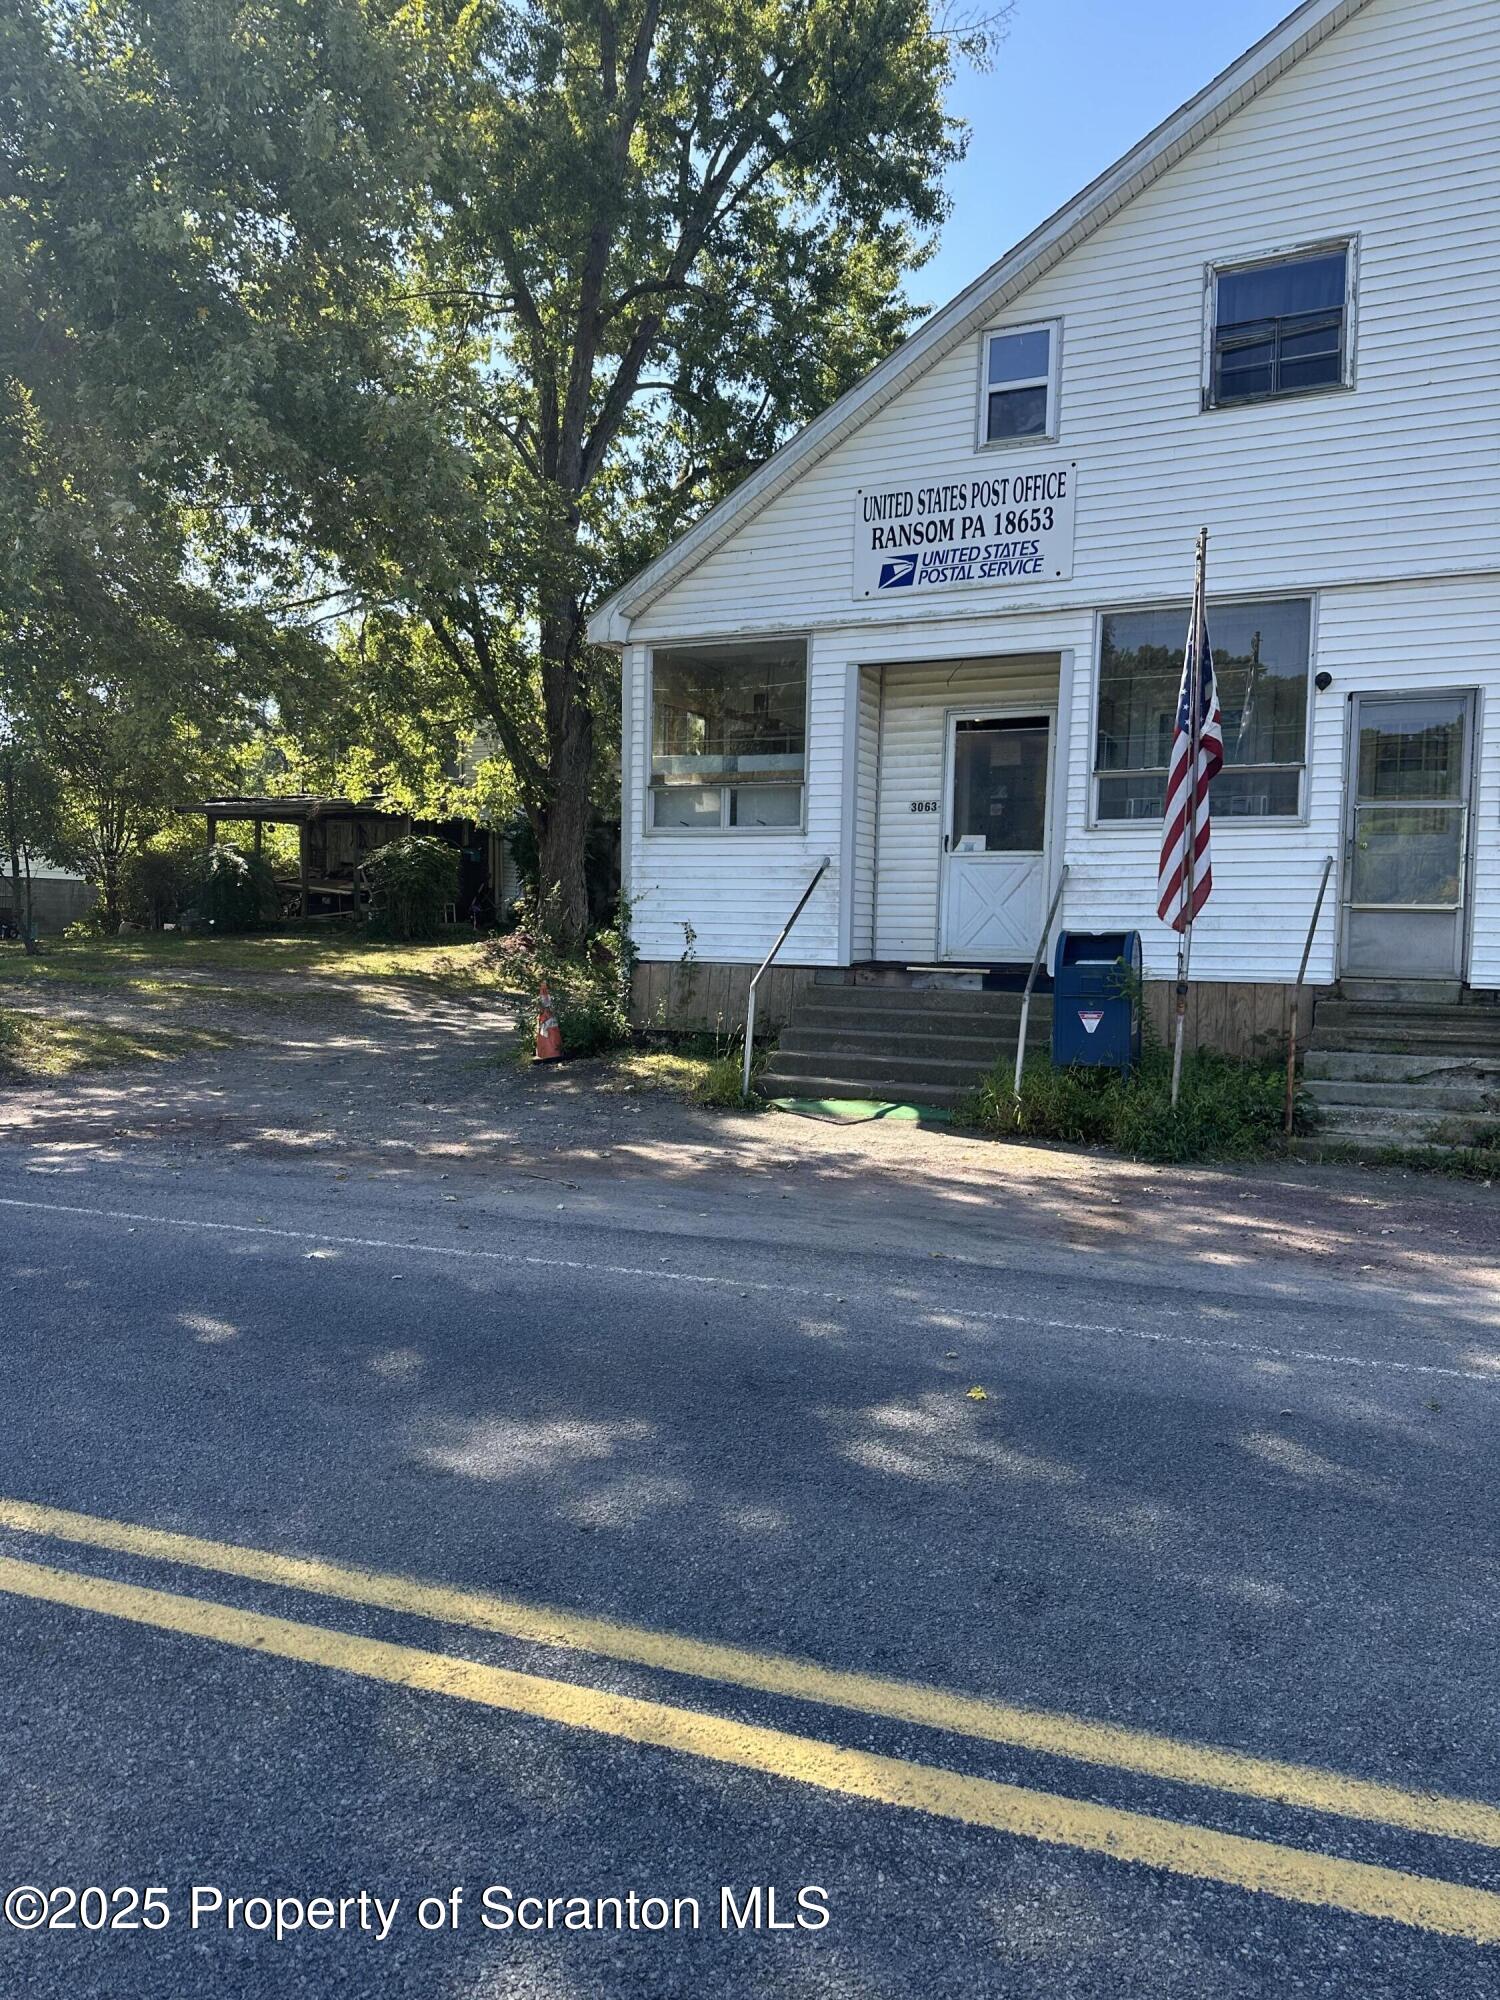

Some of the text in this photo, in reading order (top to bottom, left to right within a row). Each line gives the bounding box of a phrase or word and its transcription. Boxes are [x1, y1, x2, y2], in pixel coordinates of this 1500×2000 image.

[863, 471, 1067, 522] UNITED STATES POST OFFICE
[871, 506, 1054, 550] RANSOM PA 18653
[921, 539, 1040, 567] UNITED STATES
[918, 557, 1044, 585] POSTAL SERVICE
[911, 801, 937, 812] 3063
